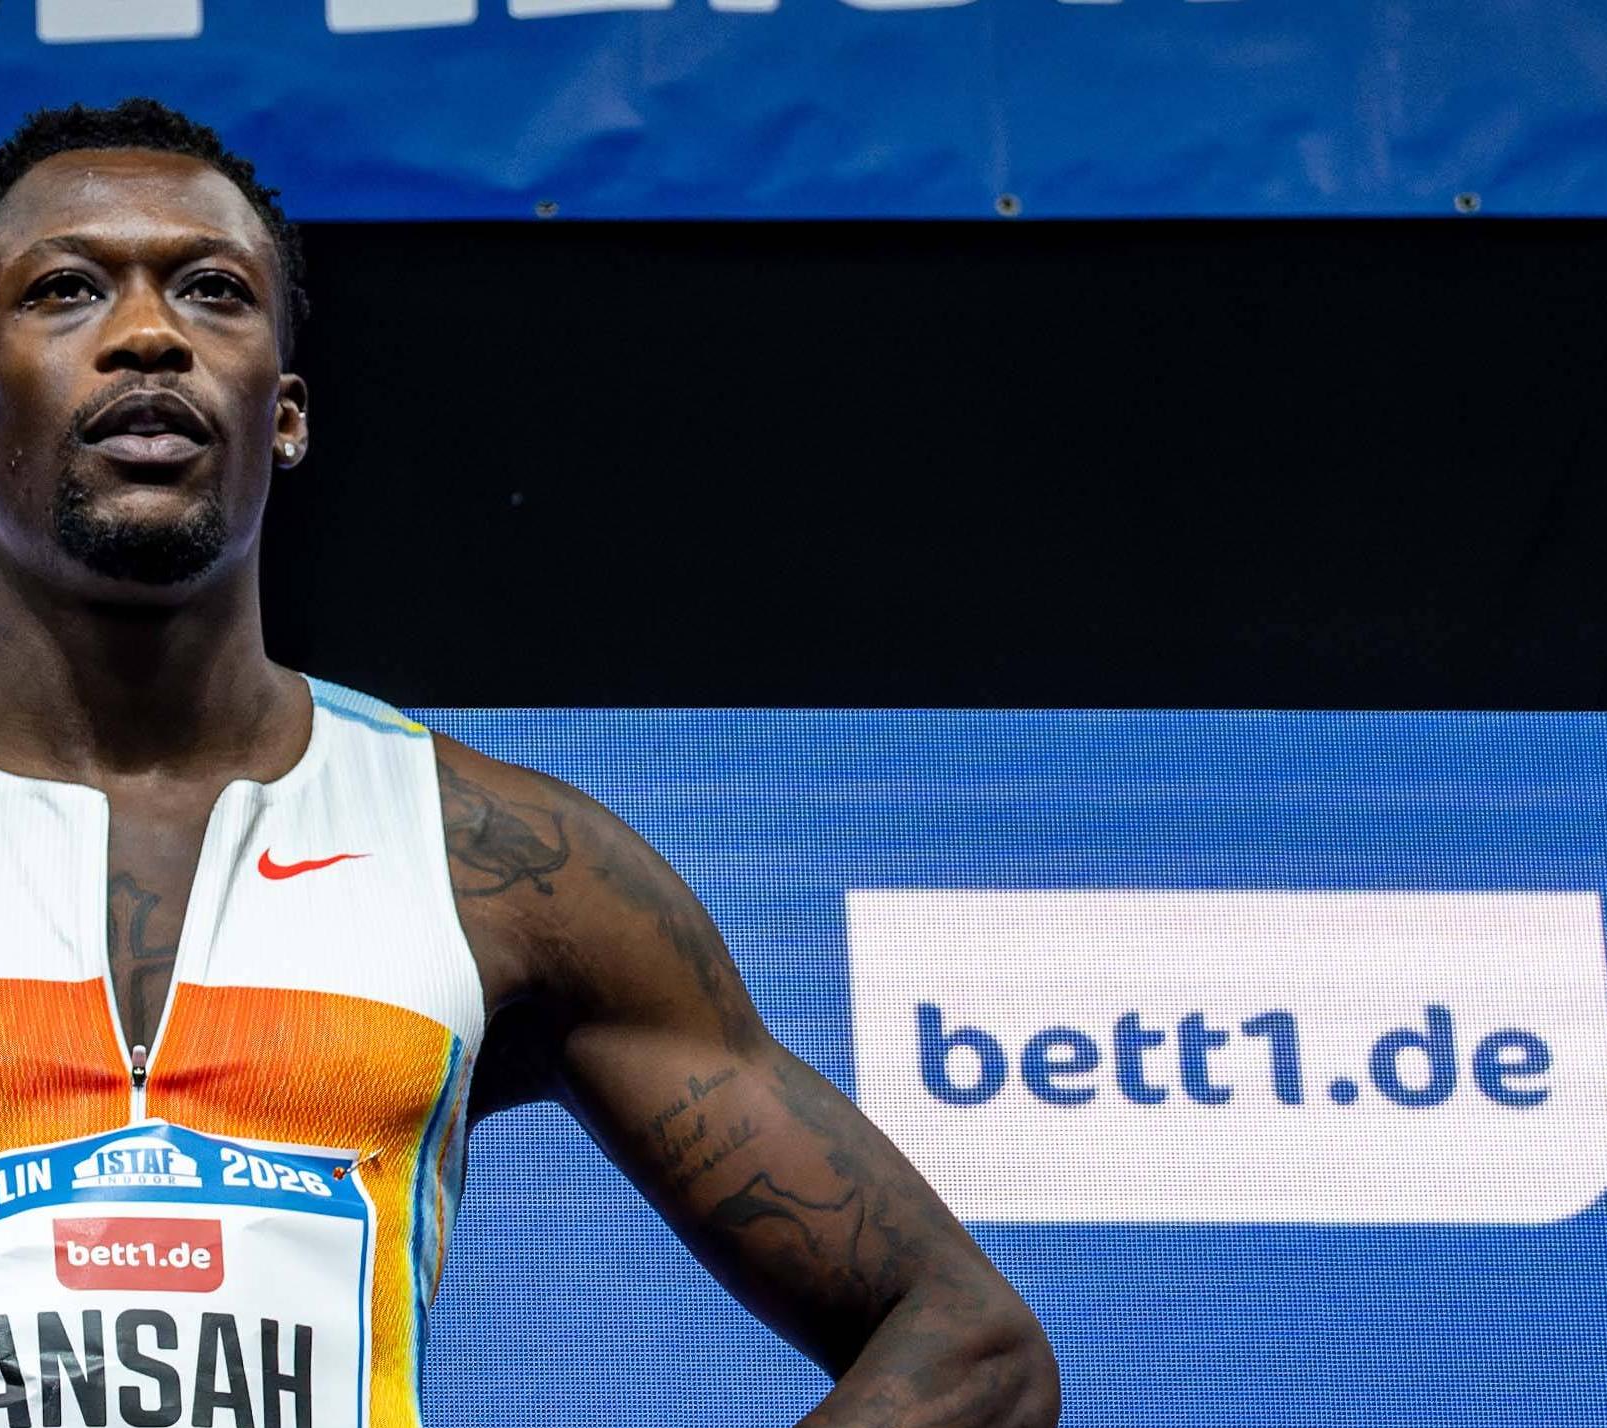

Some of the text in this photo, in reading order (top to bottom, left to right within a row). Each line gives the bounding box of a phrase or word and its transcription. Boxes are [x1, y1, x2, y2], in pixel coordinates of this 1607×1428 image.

[915, 1001, 1553, 1107] bett1.de
[98, 1148, 176, 1174] ISTAF
[220, 1148, 332, 1197] 2026
[67, 1241, 211, 1270] bett1.de
